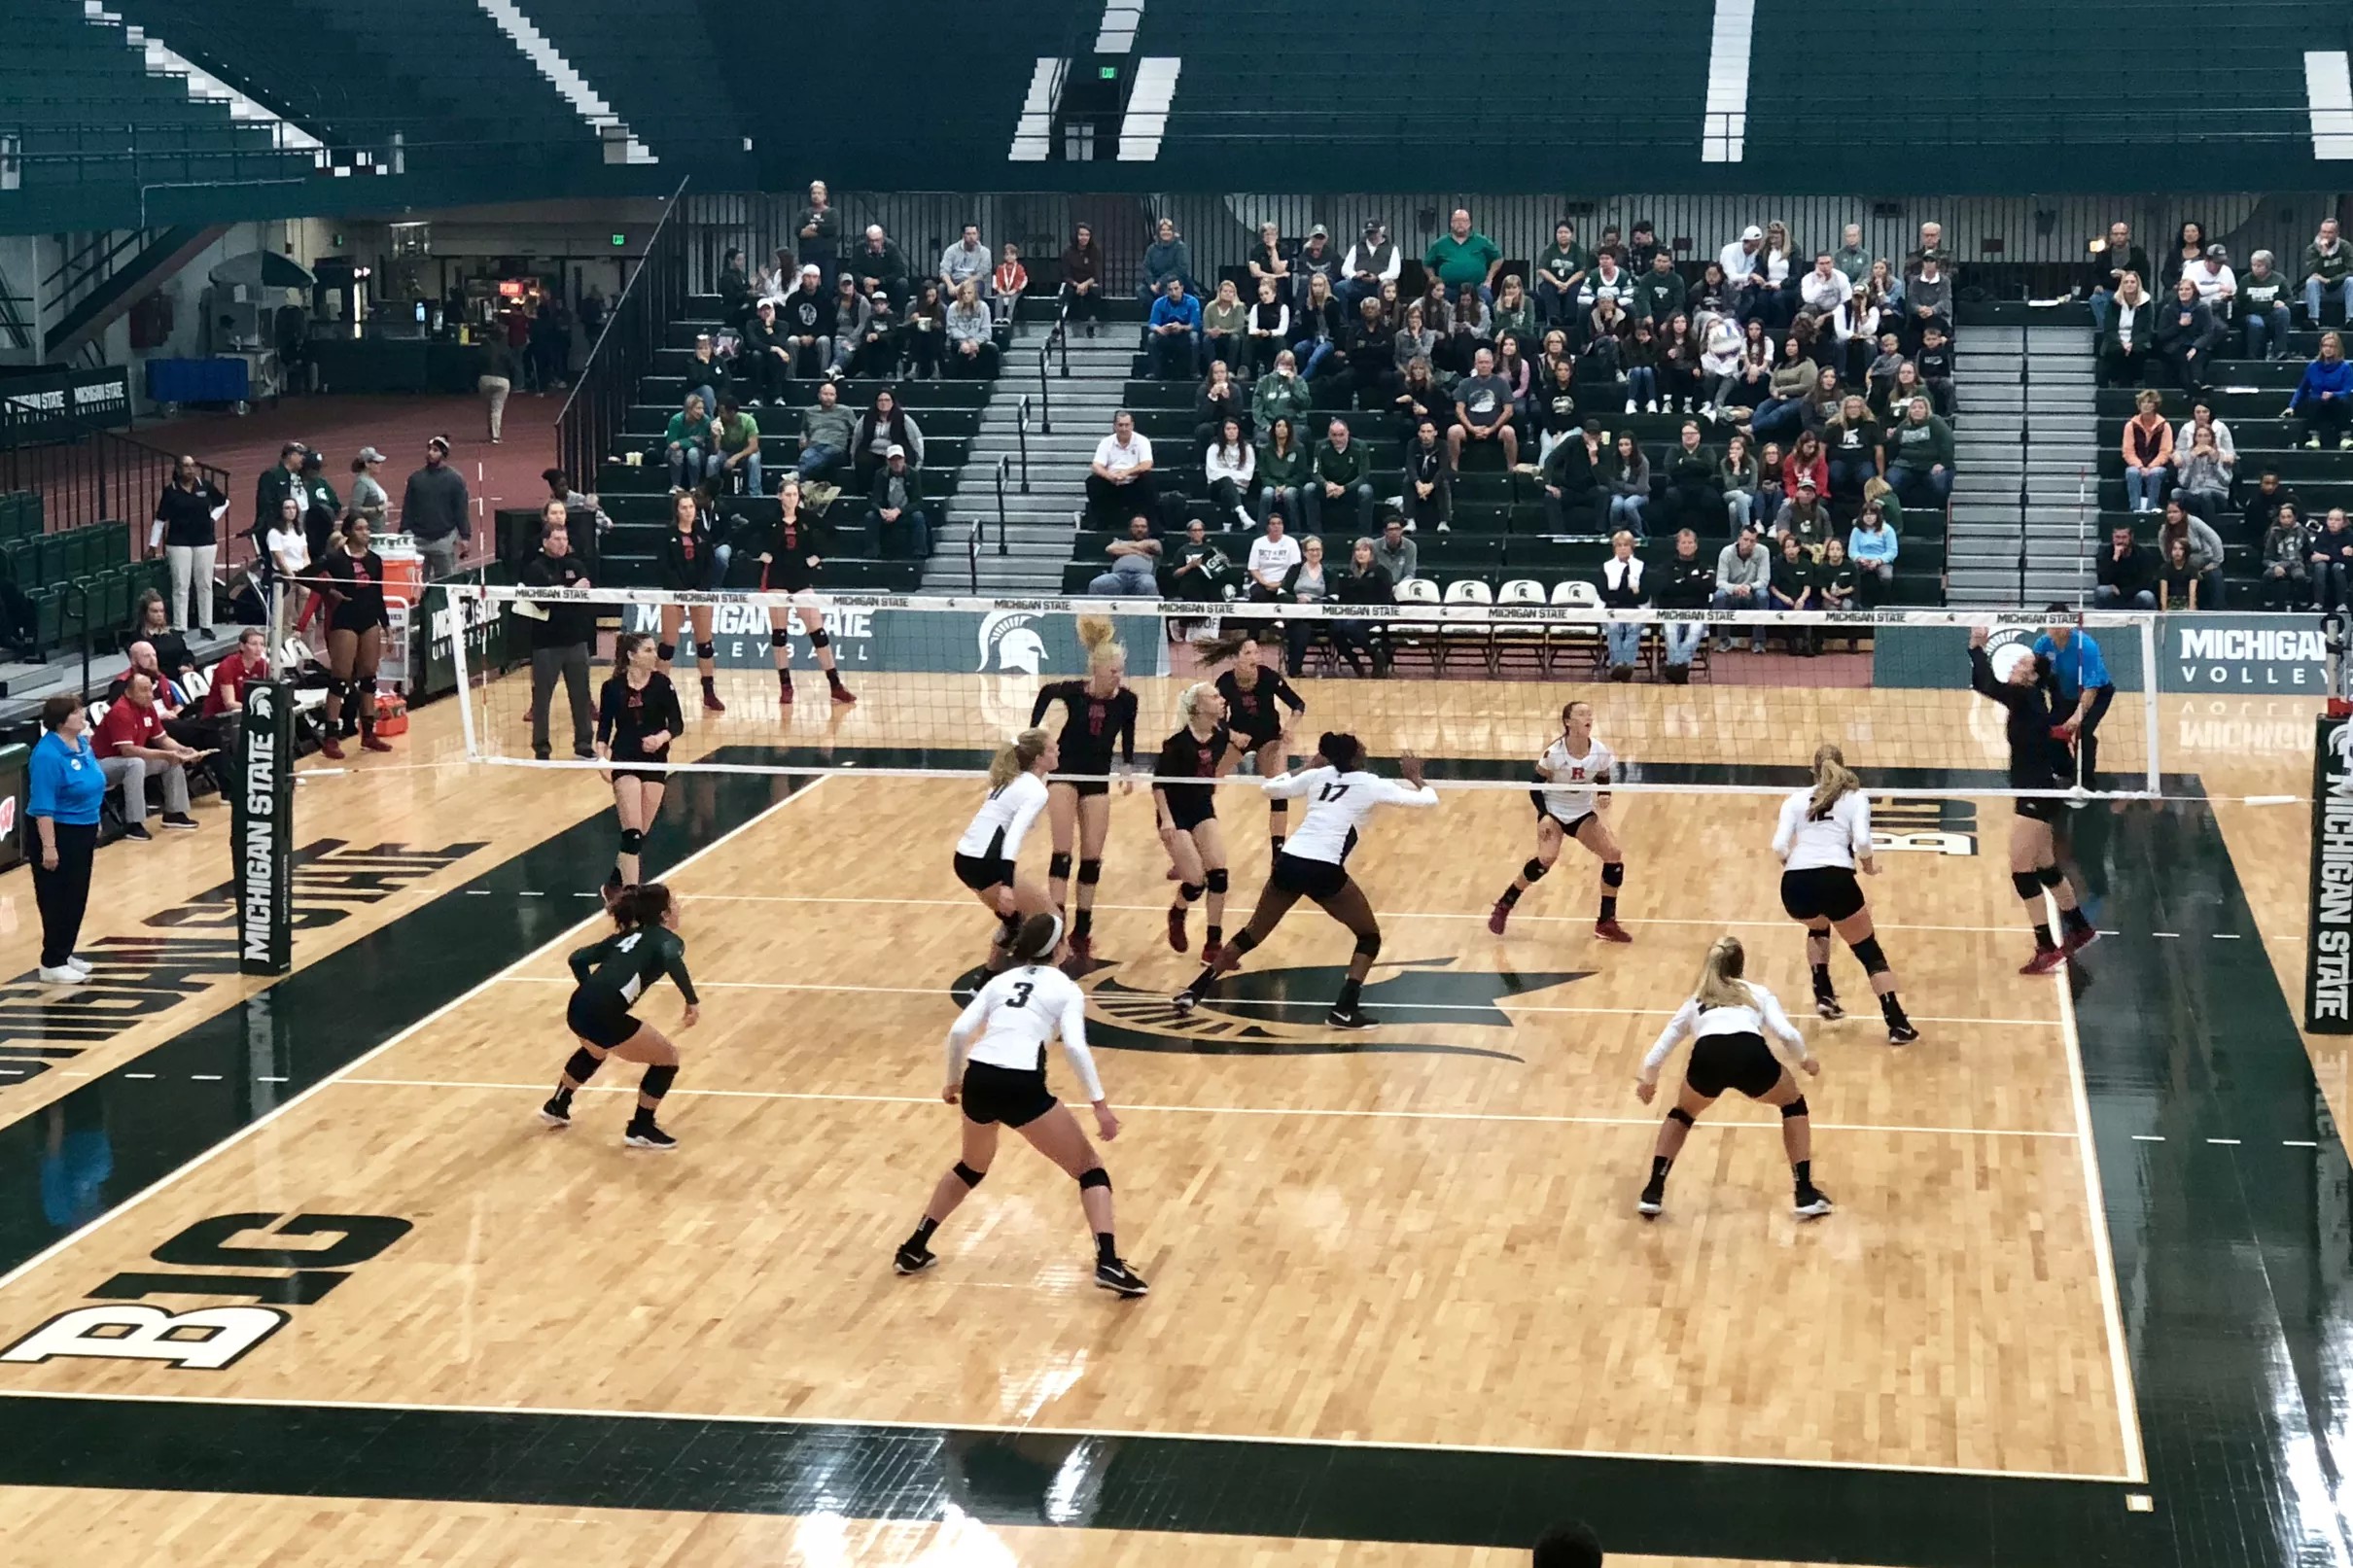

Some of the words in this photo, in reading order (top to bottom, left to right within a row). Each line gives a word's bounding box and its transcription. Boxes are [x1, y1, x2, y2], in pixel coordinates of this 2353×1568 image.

[515, 589, 560, 598] MICHIGAN
[564, 589, 588, 599] STATE
[674, 592, 719, 602] MICHIGAN
[722, 593, 747, 603] STATE
[833, 596, 878, 606] MICHIGAN
[882, 597, 907, 607] STATE
[995, 599, 1040, 610] MICHIGAN
[1043, 601, 1069, 610] STATE
[1158, 603, 1205, 612] MICHIGAN
[1208, 604, 1233, 613] STATE
[1322, 606, 1369, 615] MICHIGAN
[1373, 606, 1398, 615] STATE
[1489, 608, 1536, 617] MICHIGAN
[1539, 609, 1565, 618] STATE
[1657, 610, 1704, 620] MICHIGAN
[1708, 610, 1735, 620] STATE
[1826, 612, 1874, 622] MICHIGAN
[1878, 612, 1905, 622] STATE
[1997, 613, 2047, 623] MICHIGAN
[2050, 613, 2079, 624] STATE
[788, 607, 875, 638] SATE
[246, 729, 275, 817] STATE
[1570, 766, 1586, 781] R
[1317, 782, 1351, 803] 17
[243, 820, 273, 963] MICHIGAN
[615, 932, 643, 954] 4
[2314, 930, 2350, 1021] STATE
[1004, 982, 1034, 1008] 3
